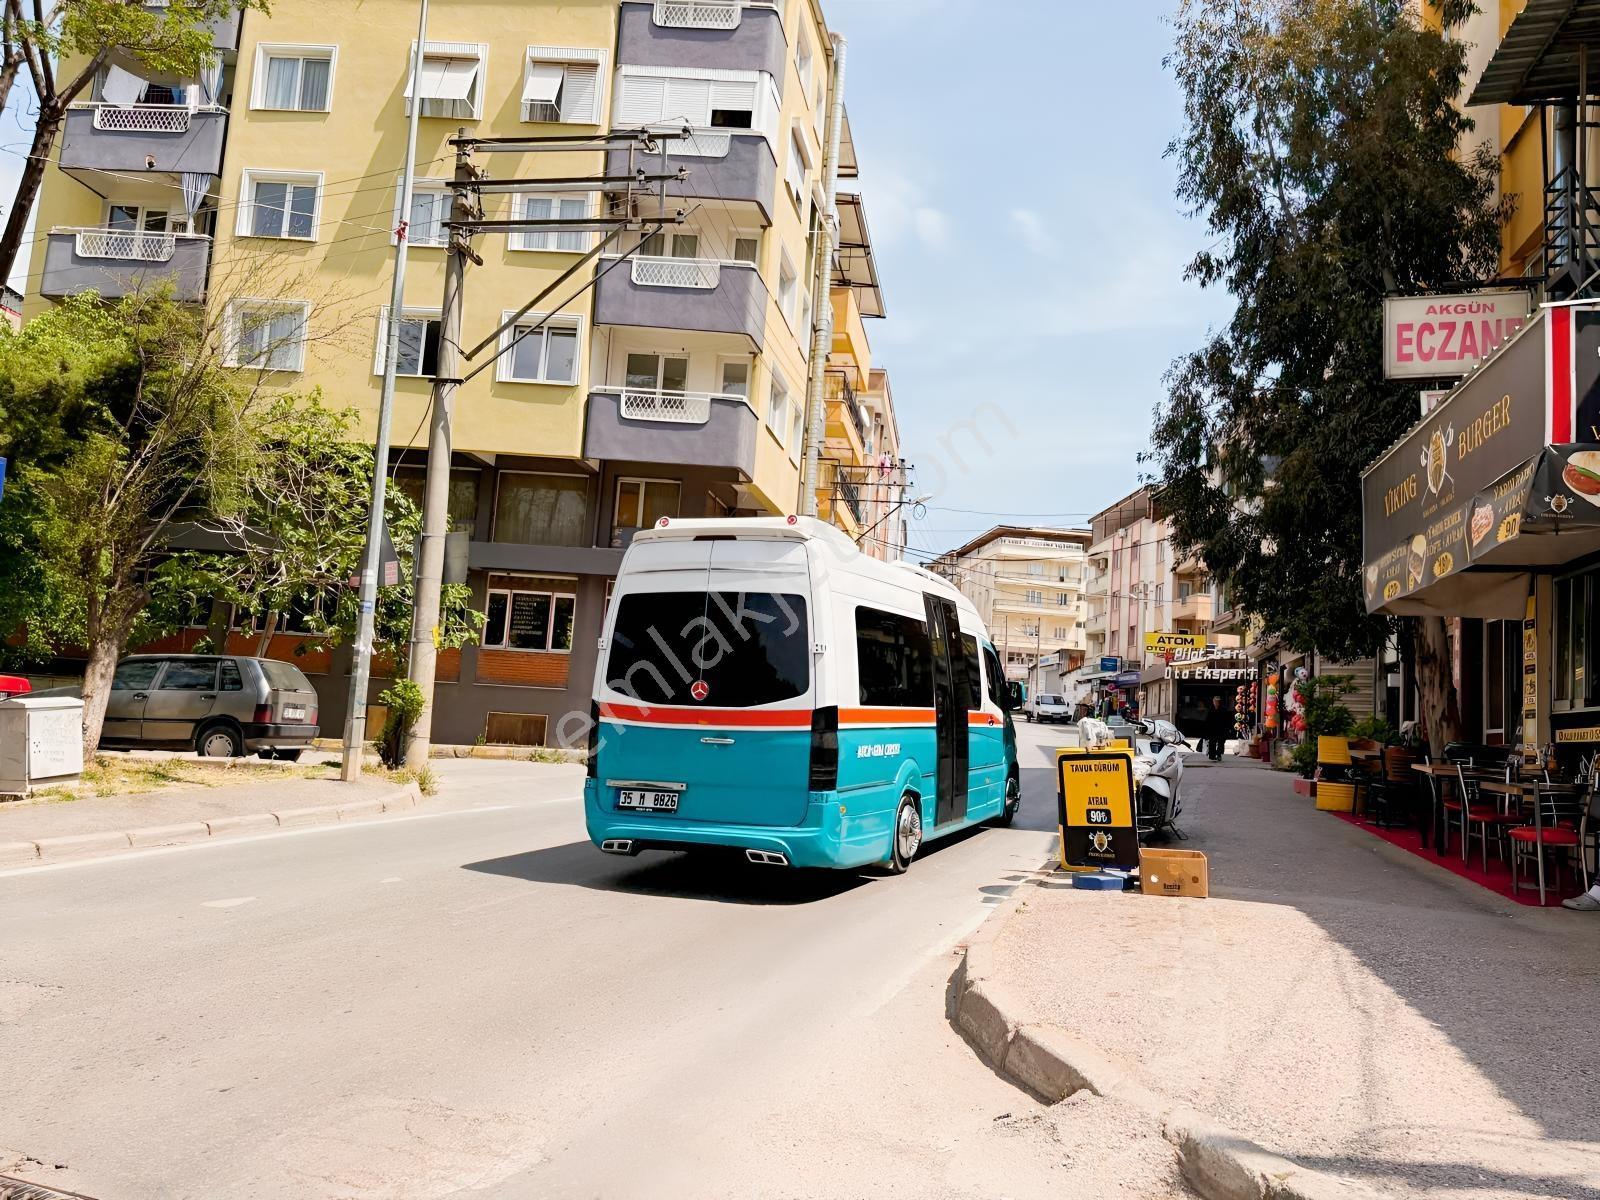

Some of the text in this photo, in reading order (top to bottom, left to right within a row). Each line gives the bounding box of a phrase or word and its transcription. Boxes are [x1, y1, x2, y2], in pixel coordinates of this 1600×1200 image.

[1425, 301, 1495, 315] AKGÜN
[1384, 474, 1417, 517] VIKING
[1458, 394, 1510, 461] BURGER
[1157, 636, 1194, 645] ATOM
[1165, 667, 1189, 679] Oto
[1070, 762, 1120, 773] TAVUK DÜRÜM
[621, 792, 677, 808] 35 M 8826
[1088, 796, 1108, 805] AYRAN
